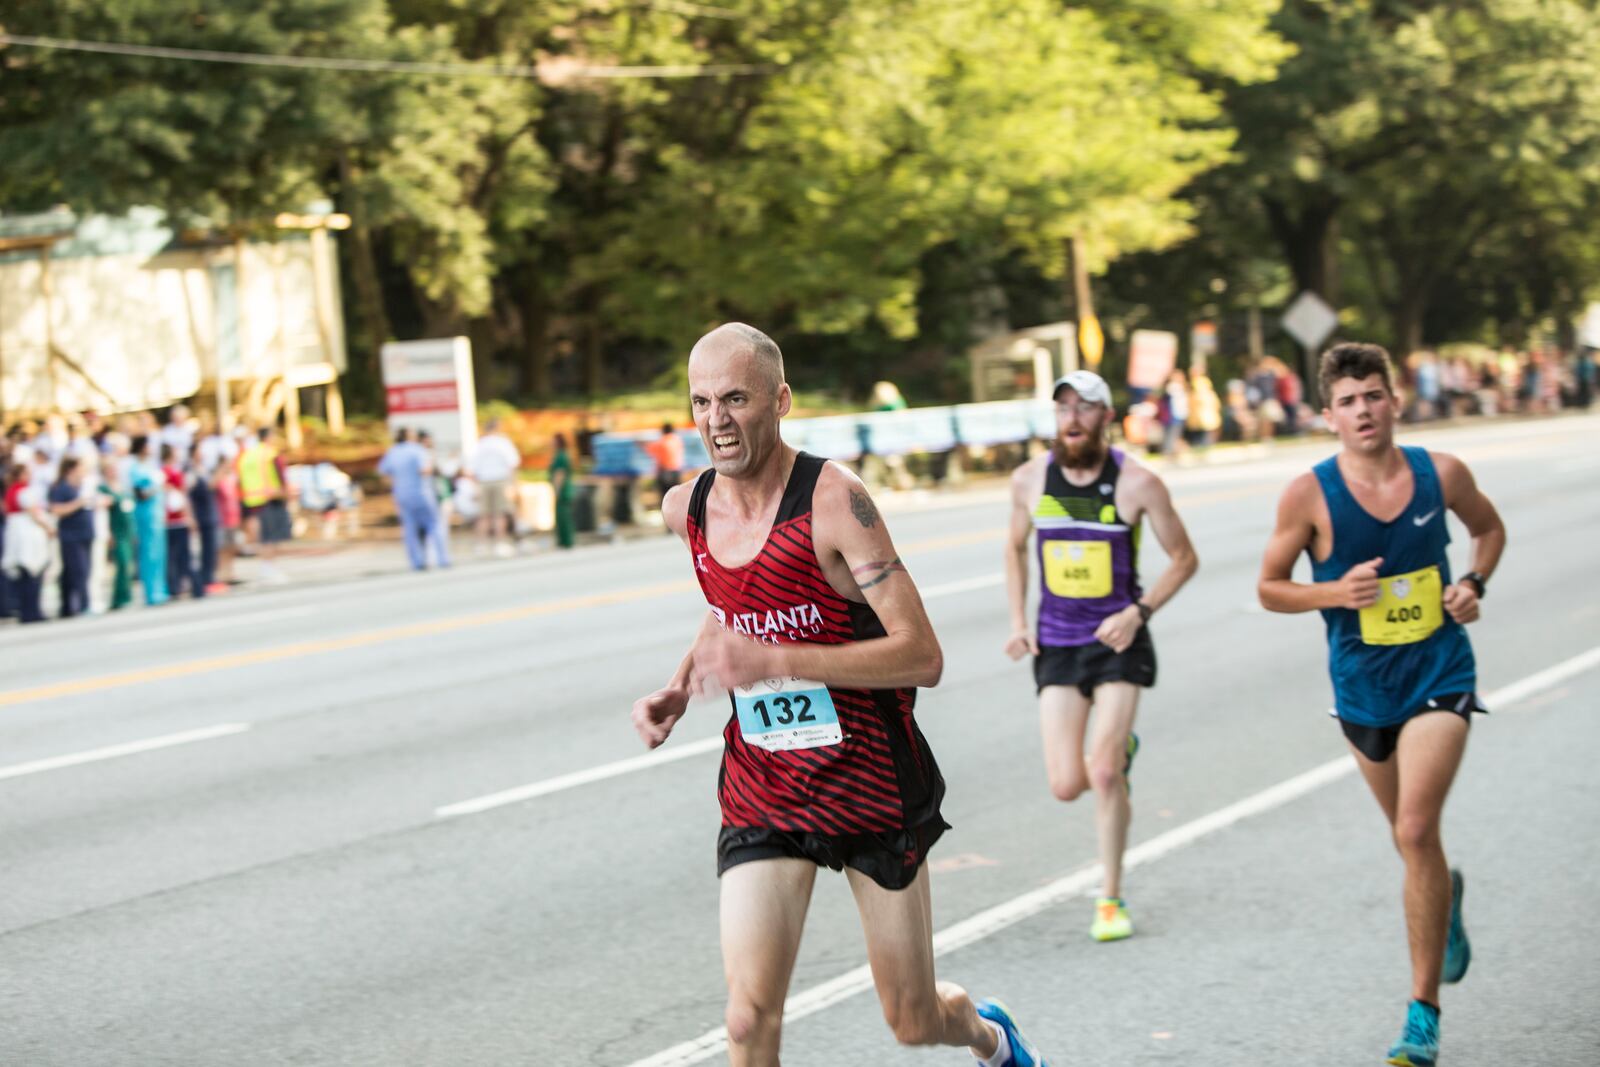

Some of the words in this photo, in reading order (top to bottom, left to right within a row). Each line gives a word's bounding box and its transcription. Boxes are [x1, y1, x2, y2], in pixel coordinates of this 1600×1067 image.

[733, 603, 824, 635] ATLANTA
[1386, 605, 1422, 623] 400
[788, 624, 821, 641] CLU
[753, 694, 817, 728] 132
